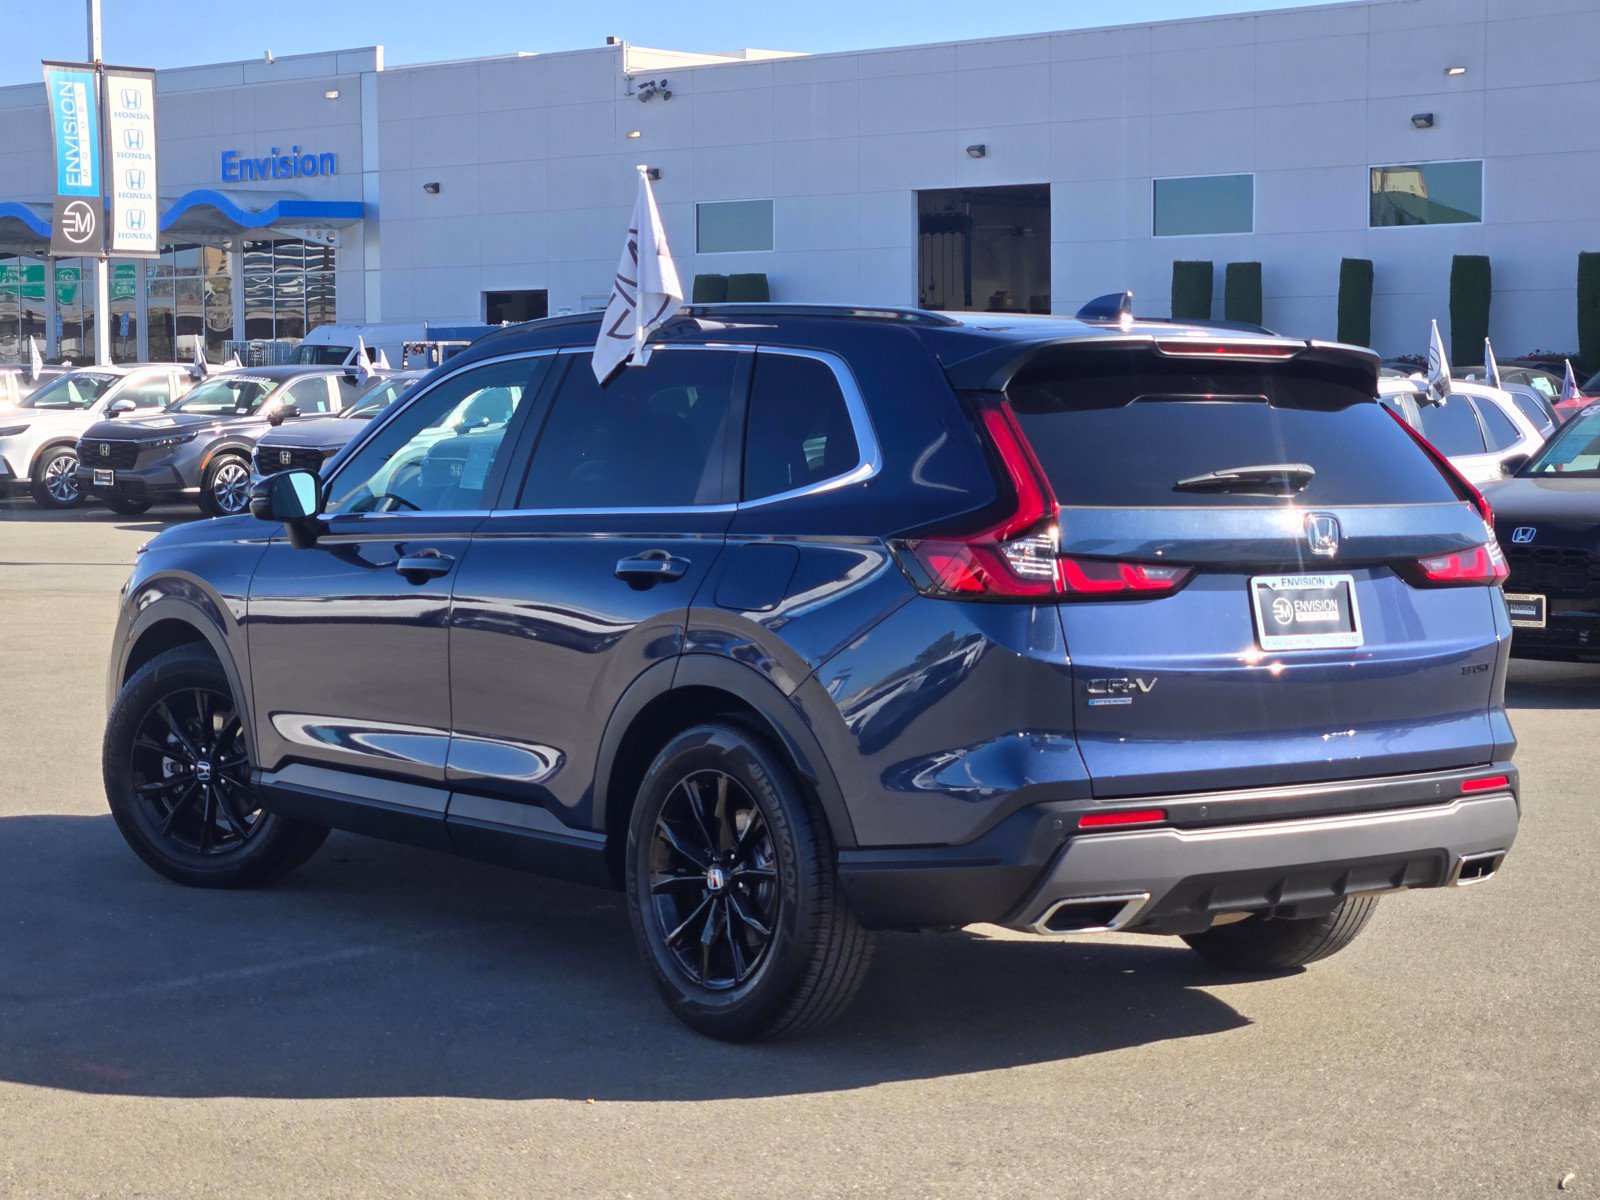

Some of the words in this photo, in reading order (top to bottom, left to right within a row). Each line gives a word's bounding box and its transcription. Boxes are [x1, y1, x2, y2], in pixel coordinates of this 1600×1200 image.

[114, 112, 150, 120] HONDA
[58, 81, 80, 186] ENVISION
[117, 152, 152, 160] HONDA
[221, 145, 336, 182] Envision
[118, 192, 153, 200] HONDA
[118, 232, 153, 240] HONDA
[1281, 577, 1325, 587] ENVISION
[1294, 600, 1338, 612] ENVISION
[1510, 603, 1536, 611] ENVISION
[1087, 677, 1158, 693] CR-V
